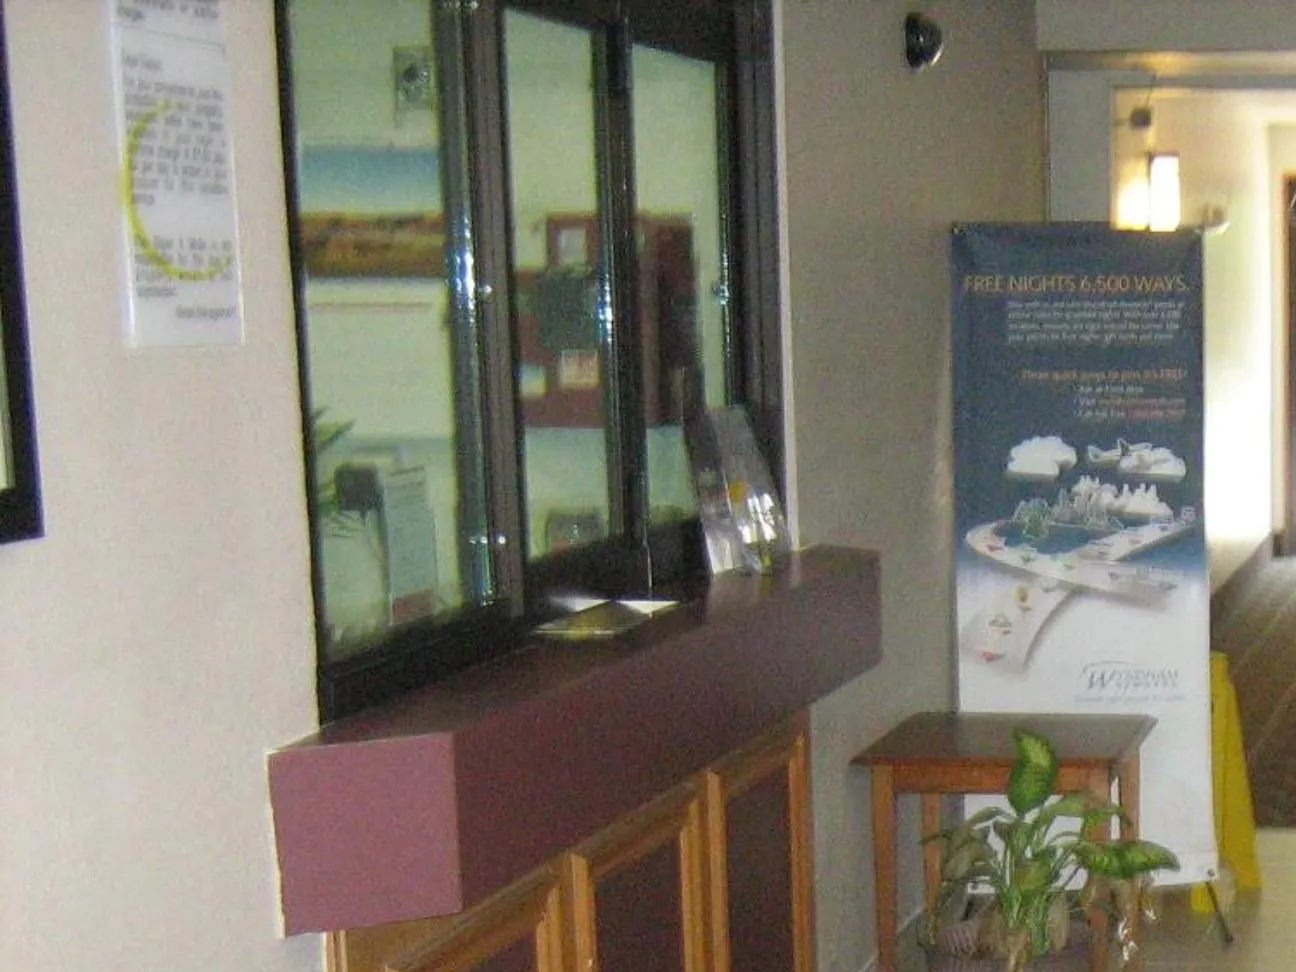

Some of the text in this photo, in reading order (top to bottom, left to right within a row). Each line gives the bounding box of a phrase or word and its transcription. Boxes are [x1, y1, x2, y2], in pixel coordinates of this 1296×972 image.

[964, 275, 1006, 293] FREE
[1009, 275, 1076, 293] NIGHTS
[1080, 275, 1130, 295] 6,500
